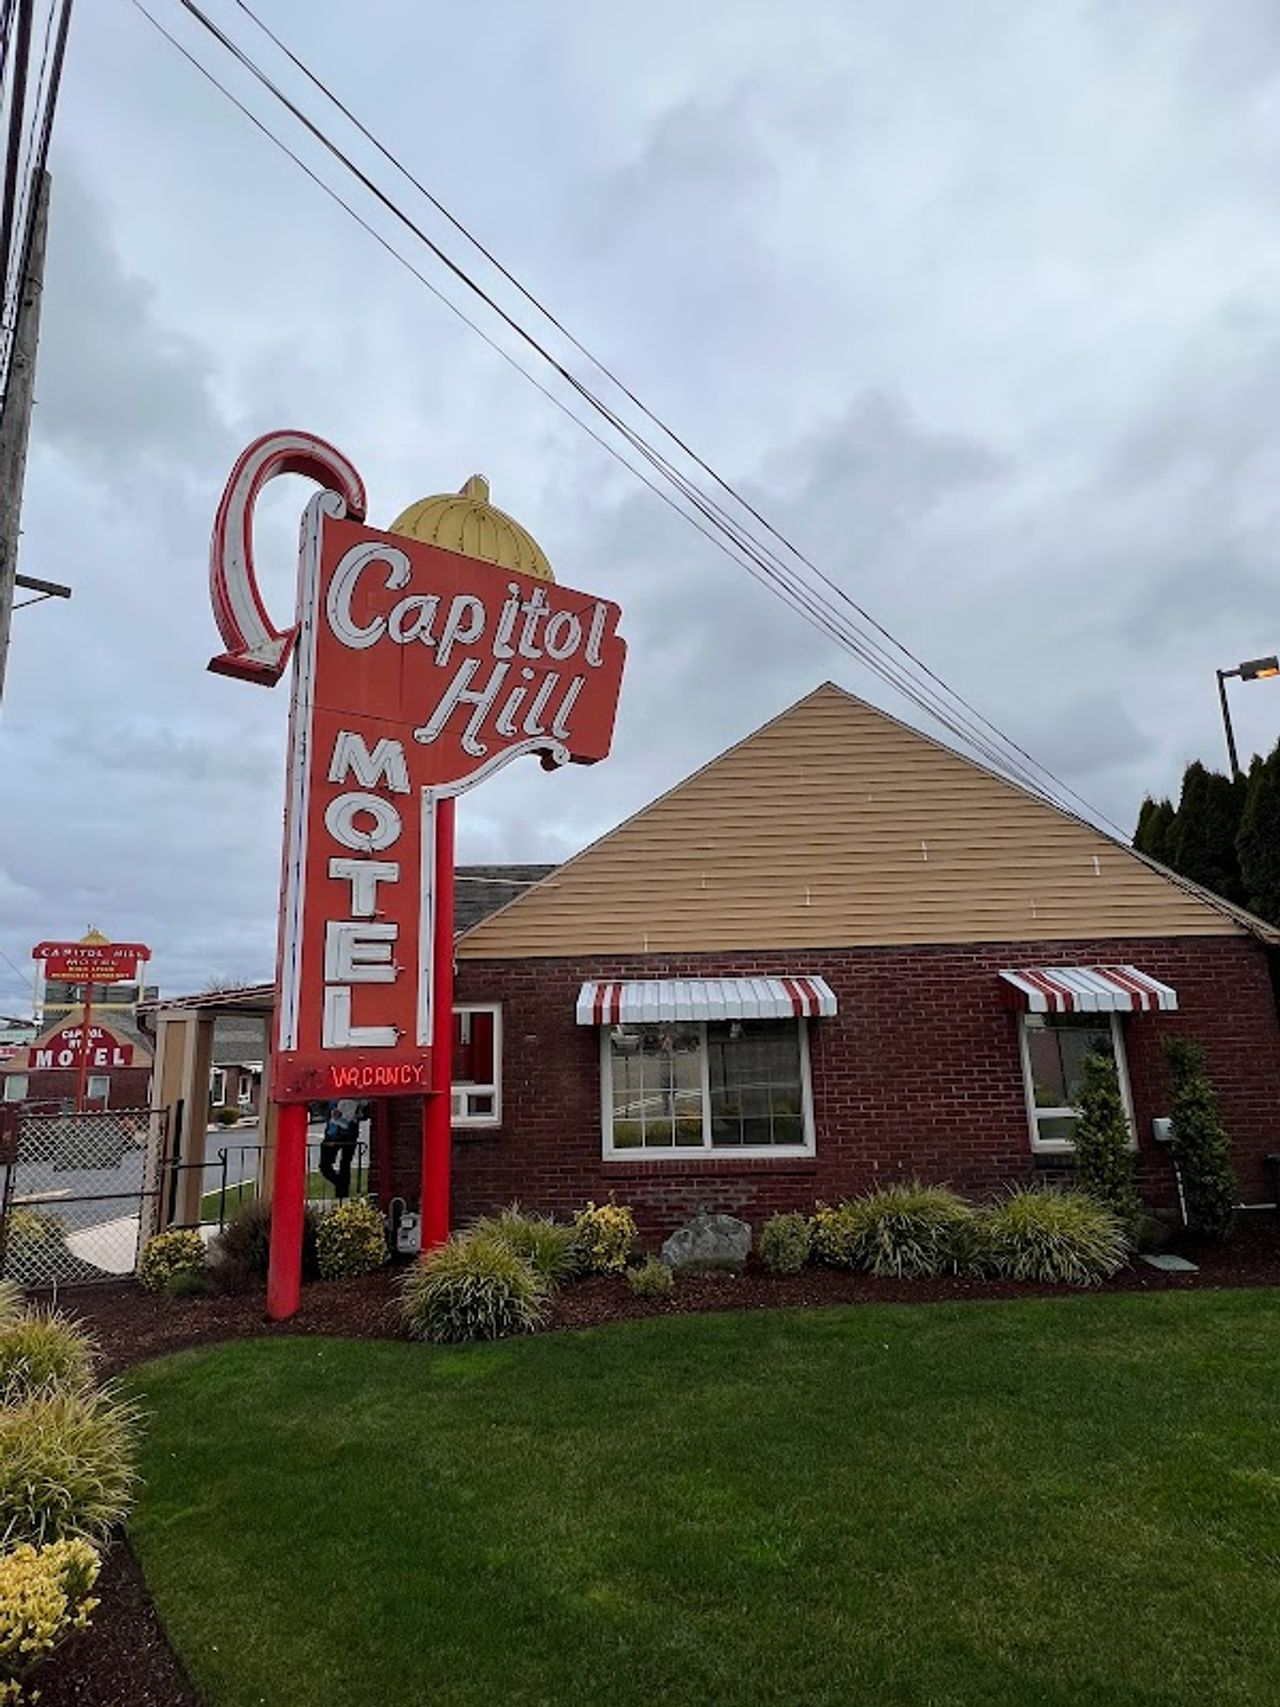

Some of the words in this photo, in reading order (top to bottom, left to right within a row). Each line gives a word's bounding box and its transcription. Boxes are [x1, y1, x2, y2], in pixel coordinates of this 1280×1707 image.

[326, 541, 608, 667] Capitol
[414, 658, 585, 756] Hill
[323, 731, 411, 1049] MOTEL
[41, 947, 103, 957] CAPITOL
[113, 949, 144, 958] HILL
[62, 1028, 103, 1039] CAPOL
[69, 1039, 94, 1048] HIL
[330, 1065, 424, 1087] VACANCY
